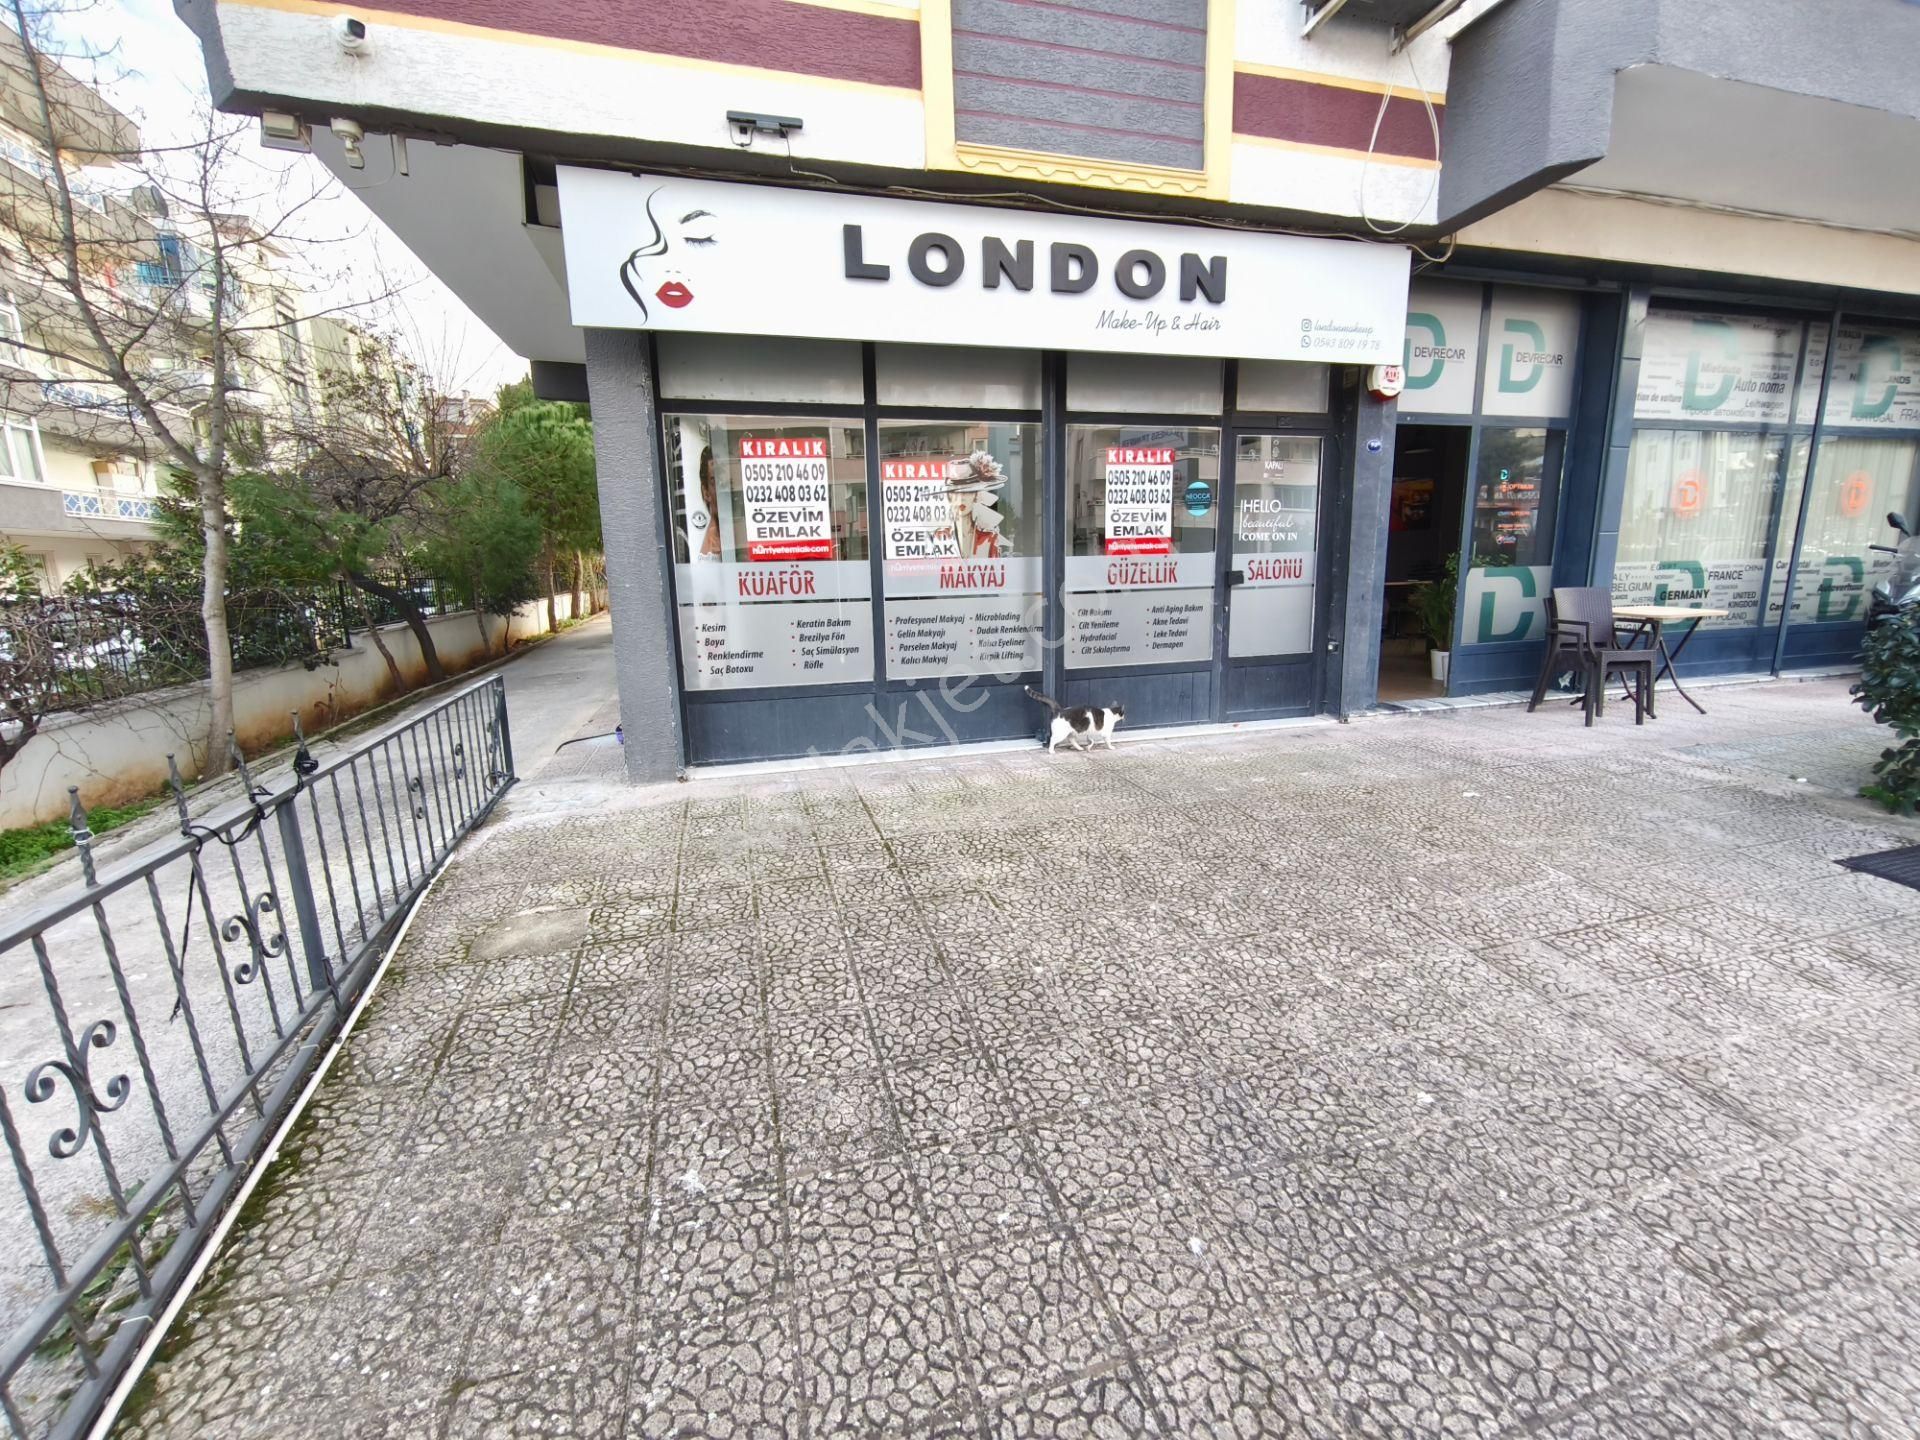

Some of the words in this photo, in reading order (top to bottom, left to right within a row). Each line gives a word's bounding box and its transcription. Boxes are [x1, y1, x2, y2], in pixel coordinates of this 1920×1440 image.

[843, 223, 1228, 304] LONDON
[1096, 309, 1168, 336] Make-Up
[1170, 315, 1181, 330] &
[1183, 312, 1221, 331] Hair
[1414, 346, 1465, 360] DEVRECAR
[1516, 351, 1564, 365] DEVRECAR
[742, 440, 824, 456] KIRALIK
[1108, 449, 1172, 463] KIRALIK
[745, 463, 773, 481] 0505
[775, 463, 793, 480] 210
[796, 463, 809, 480] 46
[811, 463, 825, 480] 09
[1107, 469, 1130, 486] 0505
[1131, 469, 1146, 485] 210
[1147, 469, 1158, 485] 46
[1160, 469, 1171, 485] 09
[746, 485, 773, 503] 0232
[775, 485, 796, 501] 408
[799, 485, 811, 501] 03
[813, 484, 826, 501] 62
[885, 485, 912, 502] 0505
[1107, 488, 1129, 505] 0232
[1130, 488, 1147, 504] 408
[1148, 488, 1159, 504] 03
[1160, 488, 1171, 504] 62
[1242, 498, 1281, 513] HELLO
[752, 507, 824, 523] ÖZEVİM
[886, 505, 911, 523] 0232
[913, 505, 932, 522] 408
[934, 505, 946, 522] 03
[1110, 508, 1167, 523] ÖZEVİM
[1242, 514, 1294, 532] beautiful
[756, 525, 822, 539] EMLAK
[1113, 524, 1164, 537] EMLAK
[1241, 531, 1270, 542] COME
[1271, 531, 1286, 541] ON
[1287, 532, 1298, 541] IN
[1107, 555, 1178, 585] GÜZELLİK
[1247, 558, 1303, 581] SALONU
[1707, 570, 1744, 580] FRANCE
[737, 564, 816, 596] KUAFÖR
[939, 564, 1006, 589] MAKYAJ
[1611, 582, 1653, 593] BELGIUM
[1659, 588, 1711, 601] GERMANY
[1732, 591, 1757, 600] UNITED
[1151, 605, 1165, 614] Anti
[1165, 604, 1184, 615] Aging
[1184, 604, 1204, 613] Bakım
[796, 619, 826, 629] Keratin
[826, 618, 852, 628] Bakım
[895, 615, 938, 626] Profesyonel
[938, 613, 966, 625] Makyaj
[974, 612, 1021, 622] Microblading
[1152, 617, 1168, 626] Akne
[1169, 616, 1189, 625] Tedavi
[701, 623, 726, 633] Kesim
[976, 626, 999, 636] Dudak
[1078, 621, 1090, 630] Cilt
[1090, 620, 1120, 630] Yenileme
[798, 632, 830, 644] Brezilya
[831, 631, 846, 641] Fön
[897, 630, 916, 639] Gelin
[1153, 630, 1168, 638] Leke
[1168, 628, 1188, 638] Tedavi
[704, 637, 725, 649] Boya
[930, 641, 958, 652] Makyaj
[998, 639, 1026, 650] Eyeliner
[1151, 641, 1184, 651] Dermapen
[707, 650, 764, 661] Renklendirme
[801, 647, 815, 657] Saç
[815, 645, 860, 656] Simülasyon
[1001, 651, 1024, 661] Lifting
[1081, 646, 1093, 655] Cilt
[803, 659, 824, 670] Röfle
[921, 654, 949, 666] Makyaj
[710, 665, 724, 676] Saç
[725, 664, 754, 674] Botoxu
